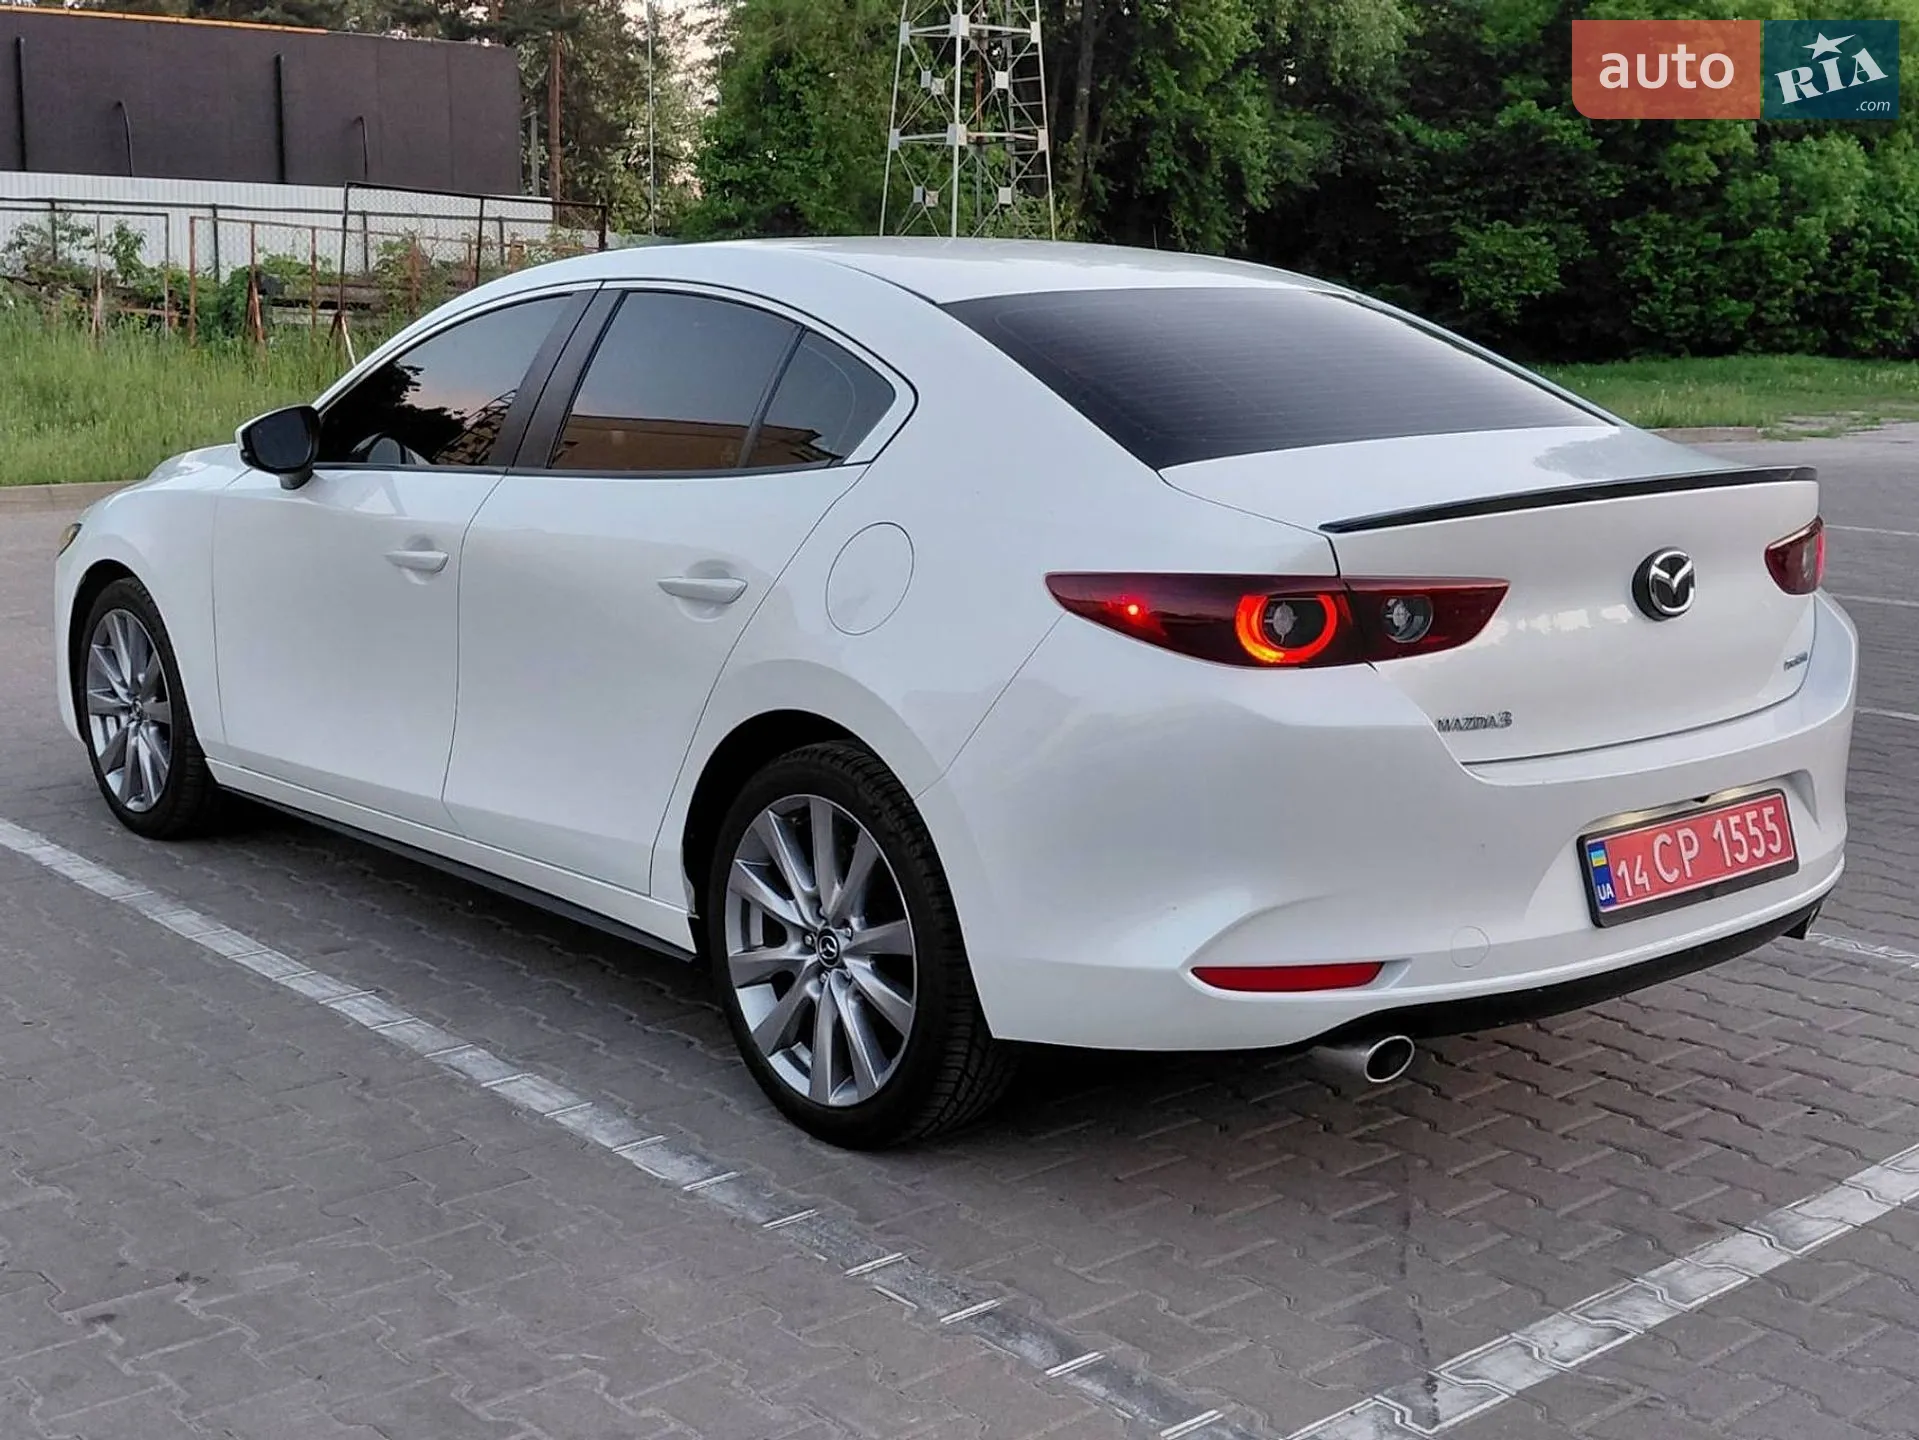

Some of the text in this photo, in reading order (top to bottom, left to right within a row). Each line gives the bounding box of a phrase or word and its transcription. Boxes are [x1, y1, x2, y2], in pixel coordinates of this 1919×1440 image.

[1437, 711, 1513, 732] MAZDA3
[1616, 806, 1782, 897] 14 CP 1555
[1598, 884, 1616, 900] UA
